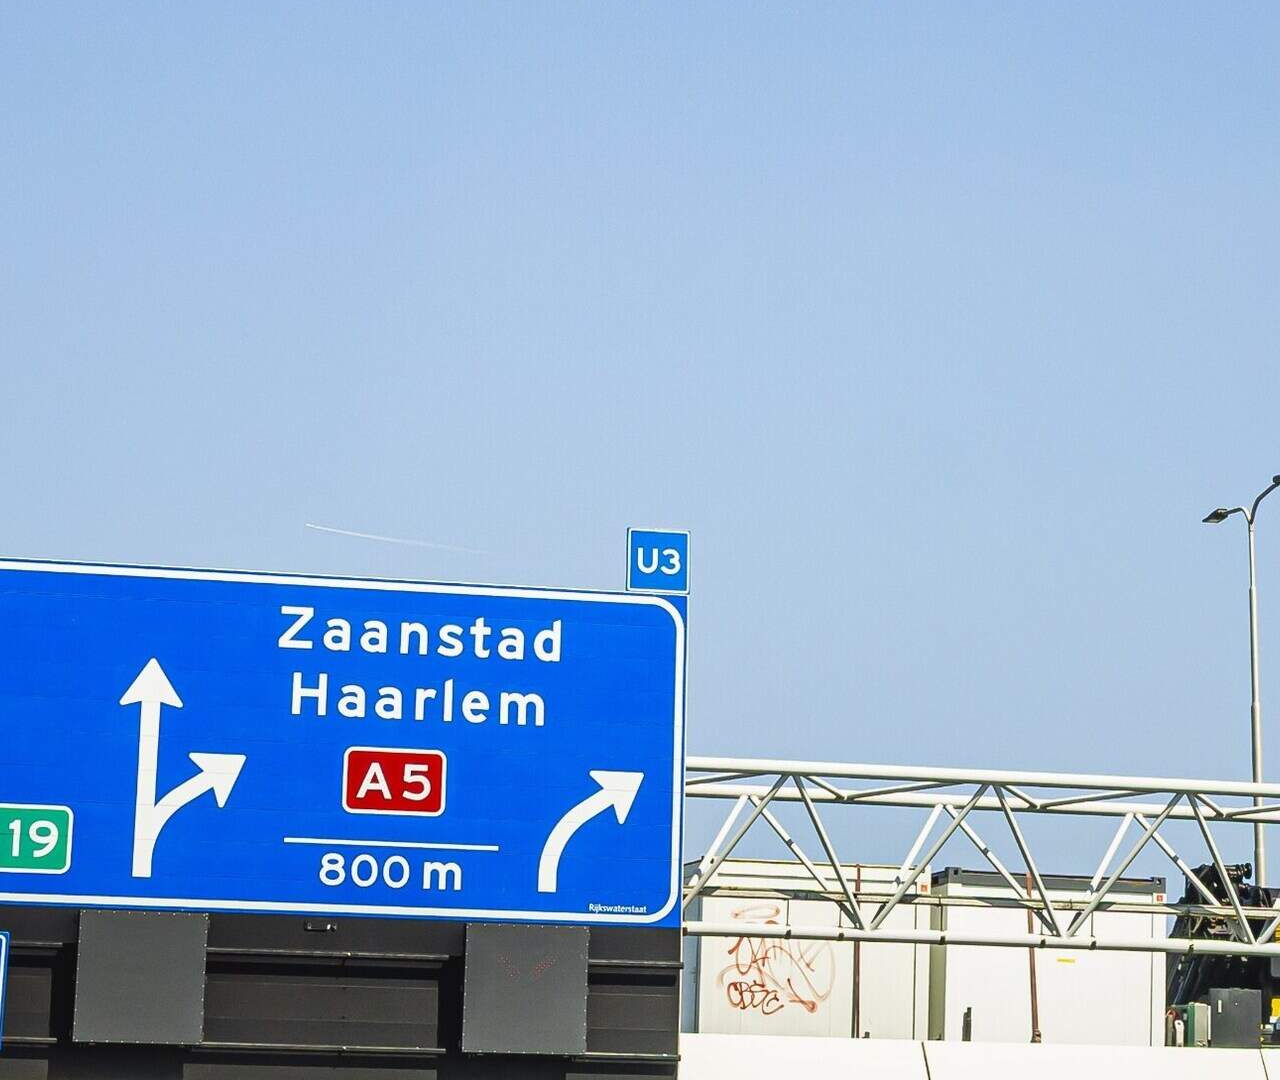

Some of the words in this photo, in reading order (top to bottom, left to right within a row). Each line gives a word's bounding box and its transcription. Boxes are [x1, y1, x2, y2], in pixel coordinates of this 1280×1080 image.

[637, 547, 681, 575] U3
[278, 605, 563, 663] Zaanstad
[291, 671, 546, 727] Haarlem
[355, 762, 432, 801] A5
[318, 851, 411, 890] 800
[421, 858, 463, 891] m
[588, 903, 647, 914] Rijkswaterstaat
